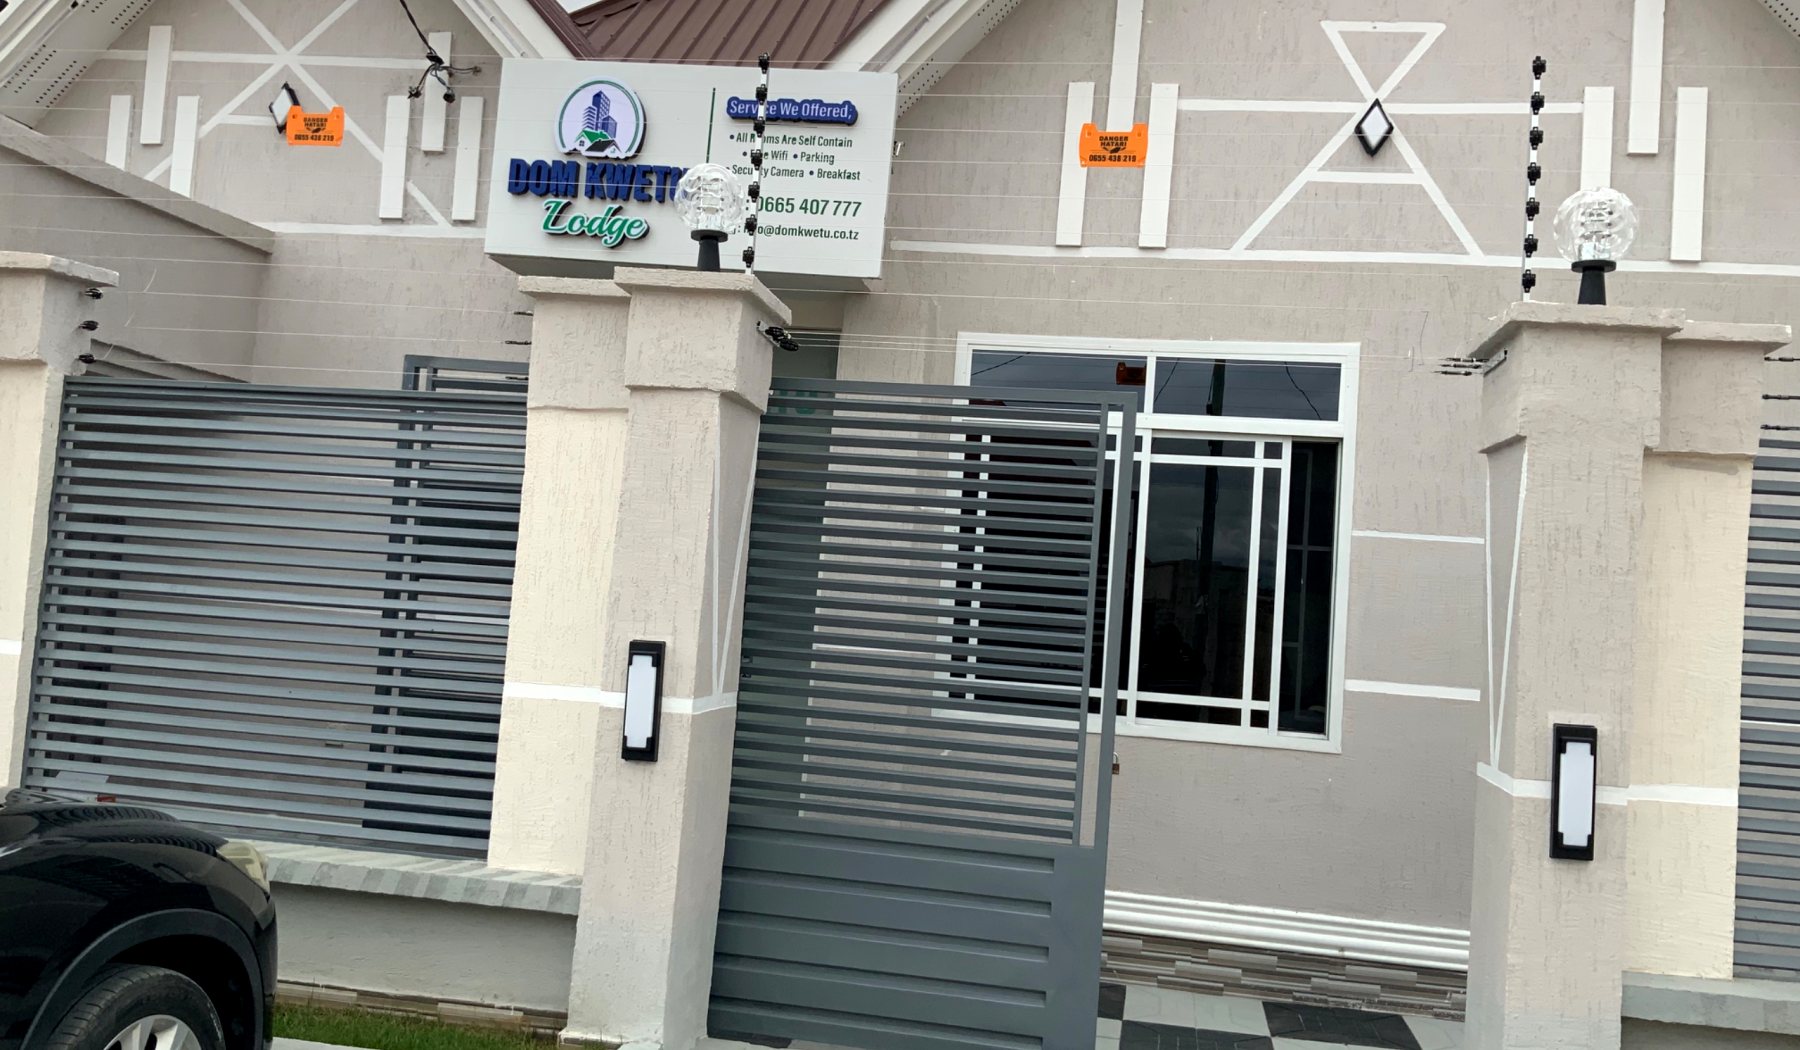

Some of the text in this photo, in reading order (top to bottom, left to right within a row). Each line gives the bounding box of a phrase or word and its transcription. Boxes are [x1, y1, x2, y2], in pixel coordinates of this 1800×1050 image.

[730, 100, 777, 115] Servce
[780, 101, 799, 116] We
[736, 132, 748, 143] All
[781, 134, 797, 145] Are
[798, 135, 817, 146] Self
[817, 136, 853, 147] Contain
[771, 150, 788, 161] Wifi
[800, 152, 835, 165] Parking
[1089, 154, 1106, 162] 0655
[508, 158, 580, 198] DOM
[770, 166, 804, 178] Camera
[817, 168, 861, 180] Breakfast
[799, 198, 830, 215] 407
[832, 200, 862, 217] 777
[543, 200, 647, 247] Lodge
